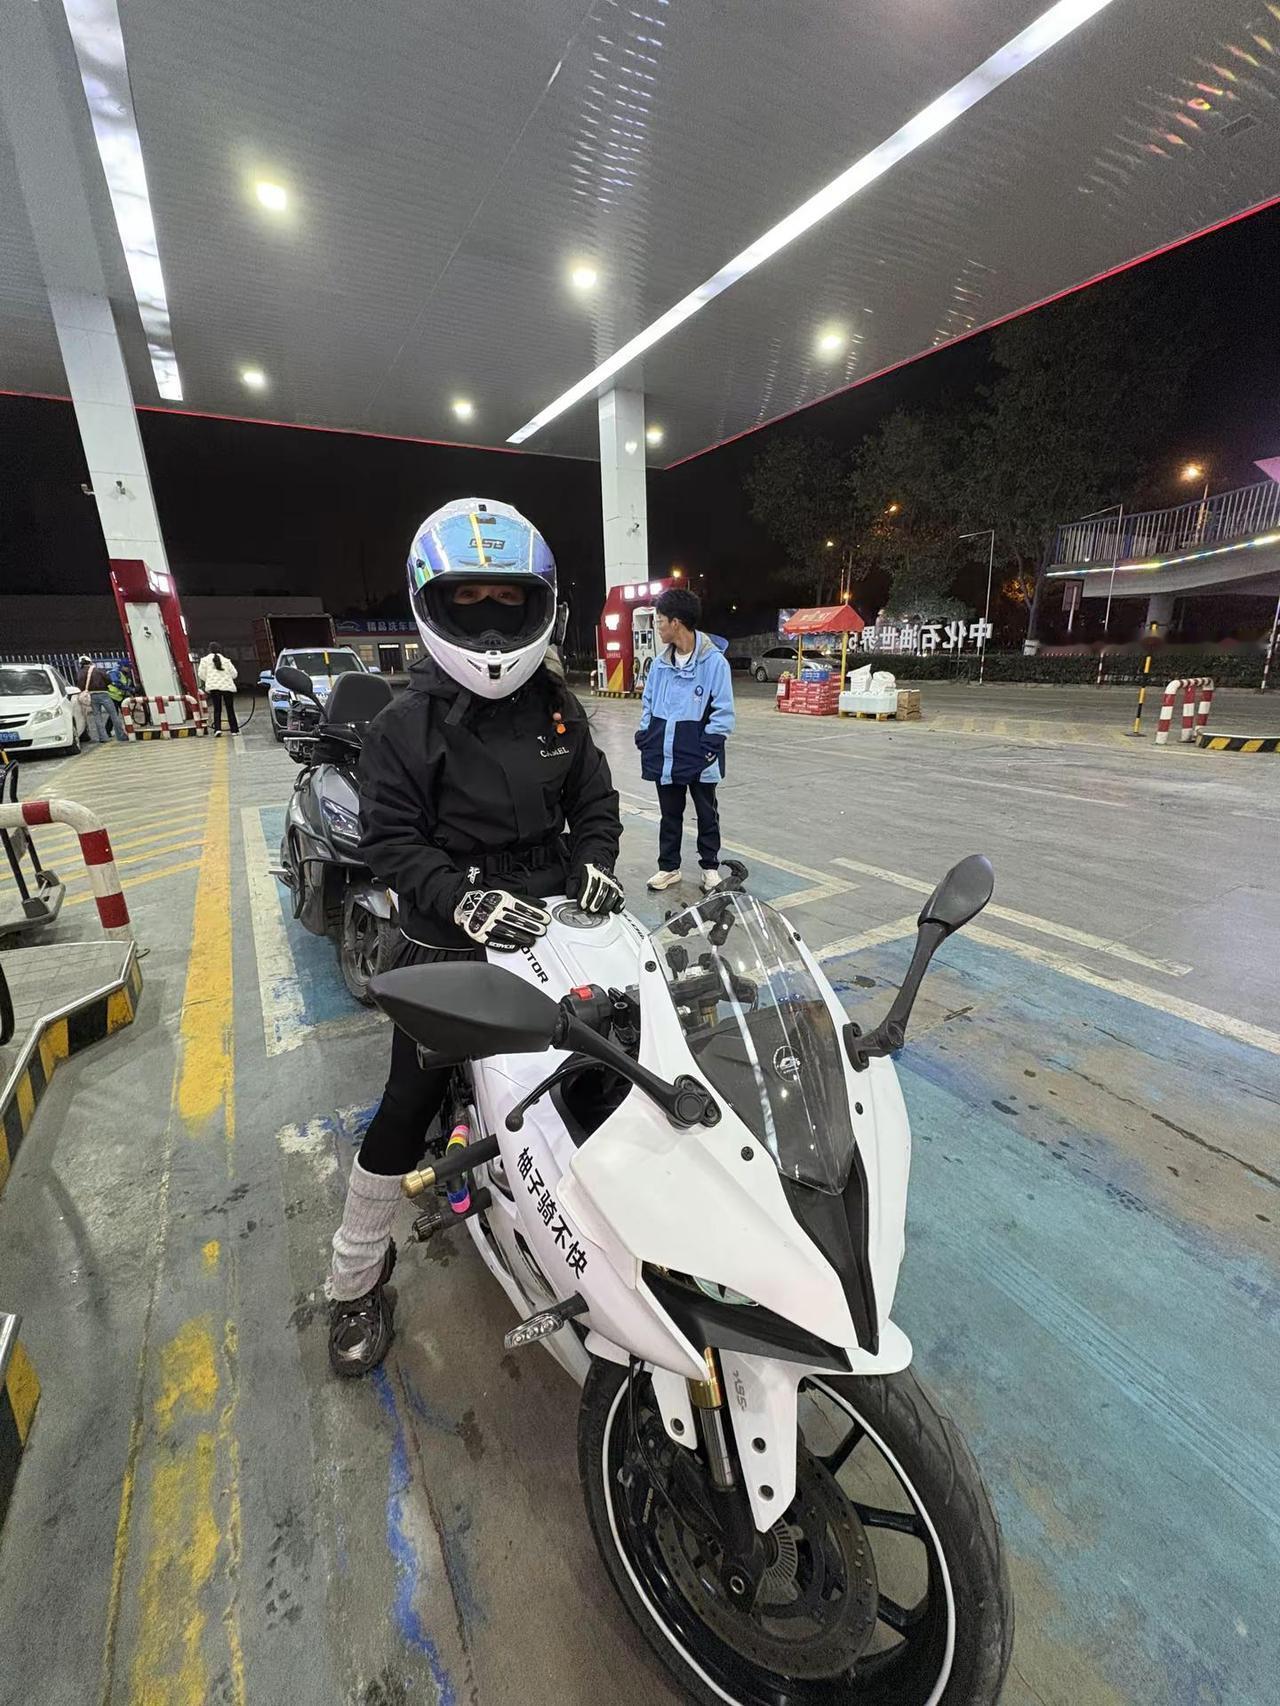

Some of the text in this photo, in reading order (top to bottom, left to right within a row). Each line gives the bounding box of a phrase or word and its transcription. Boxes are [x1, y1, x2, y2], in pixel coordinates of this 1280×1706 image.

[520, 943, 550, 985] OTOR
[517, 1146, 588, 1280] 柚子骑不快
